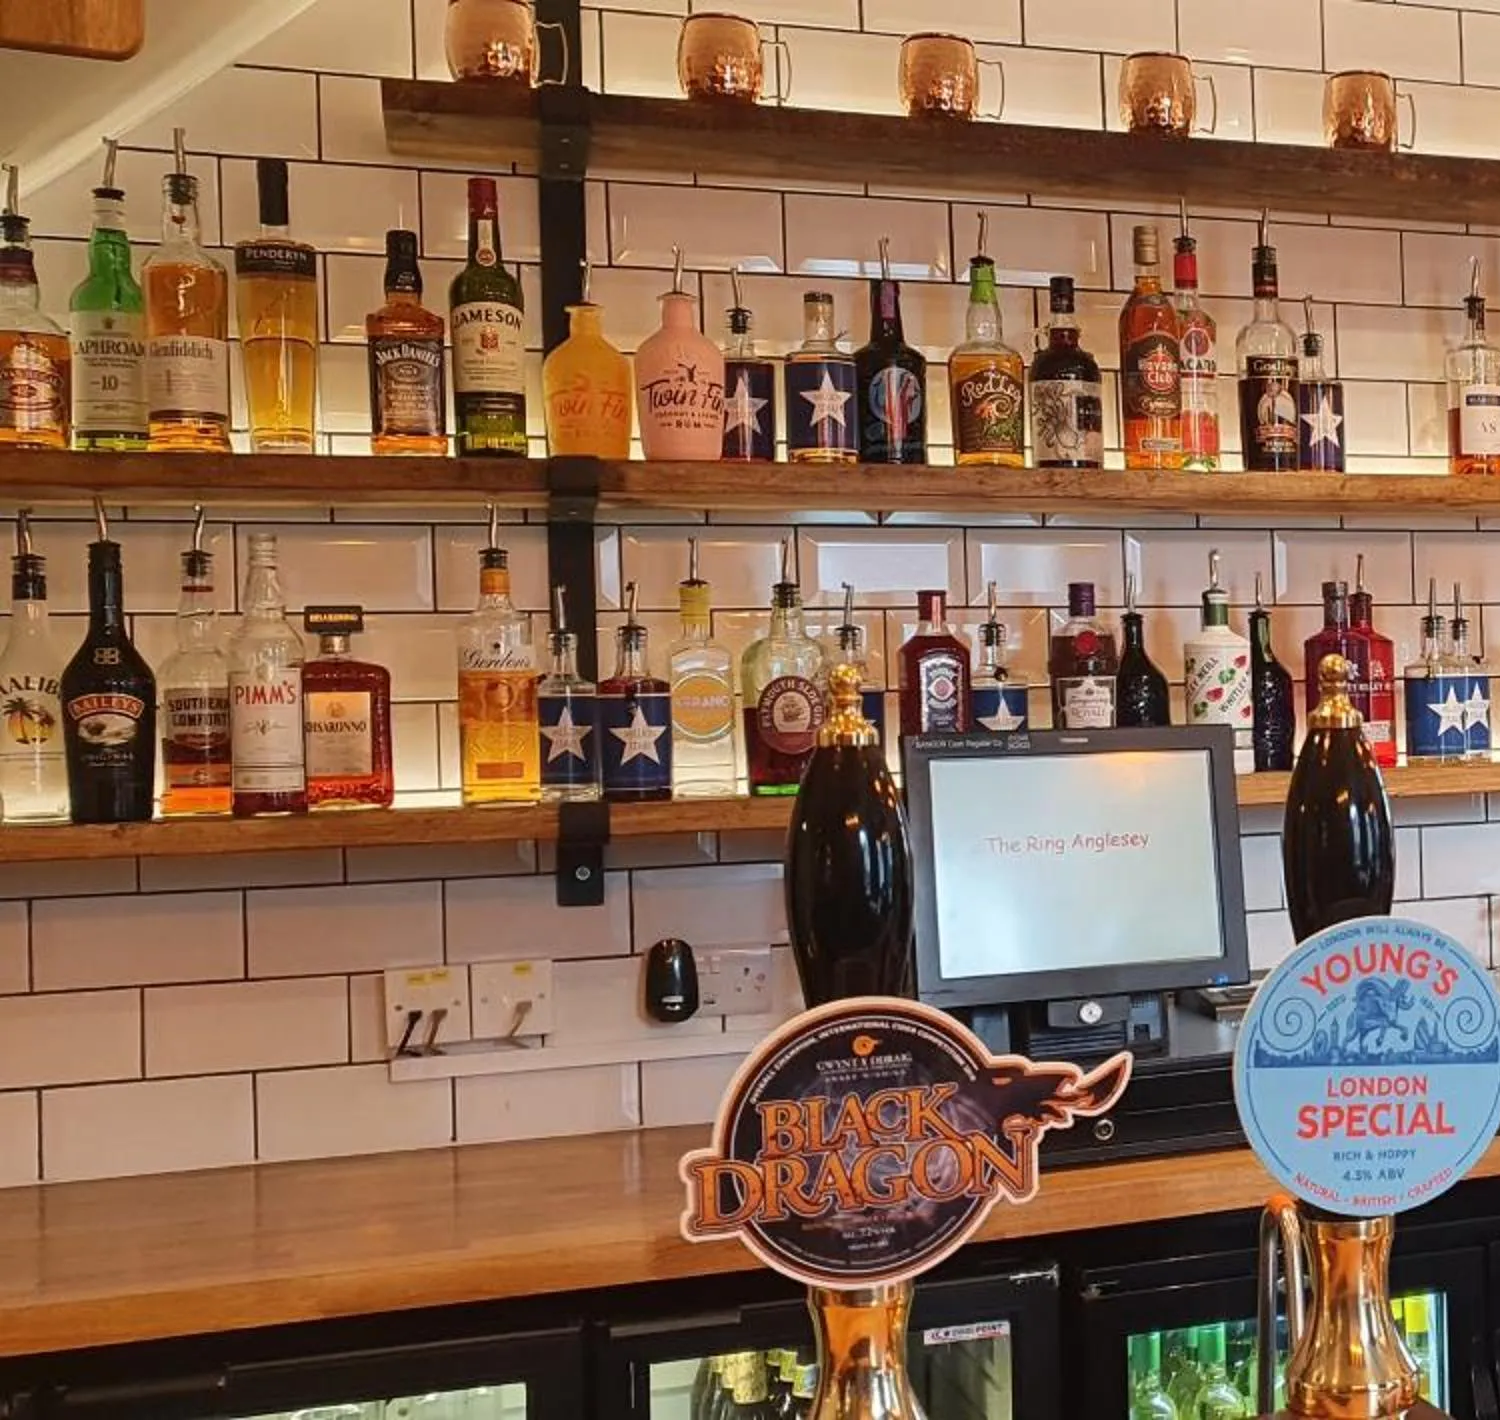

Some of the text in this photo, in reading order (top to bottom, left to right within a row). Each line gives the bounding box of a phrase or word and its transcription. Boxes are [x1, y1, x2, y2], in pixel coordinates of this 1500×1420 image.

[454, 308, 522, 331] JAMESON
[101, 376, 119, 391] 10
[640, 378, 698, 413] Twin
[0, 675, 61, 700] ALIB
[235, 680, 297, 705] PIMM'S
[305, 720, 368, 733] DISARONNO
[984, 831, 1149, 855] The Ring Anglesey
[1300, 942, 1459, 997] YOUNG'S
[1326, 1075, 1428, 1098] LONDON
[759, 1083, 968, 1160] BLACK
[1296, 1100, 1456, 1140] SPECIAL
[1332, 1148, 1417, 1162] RICH & HOPPY
[694, 1125, 1037, 1231] DRAGON
[1294, 1171, 1341, 1202] NATURAL
[1377, 1167, 1406, 1181] ABV
